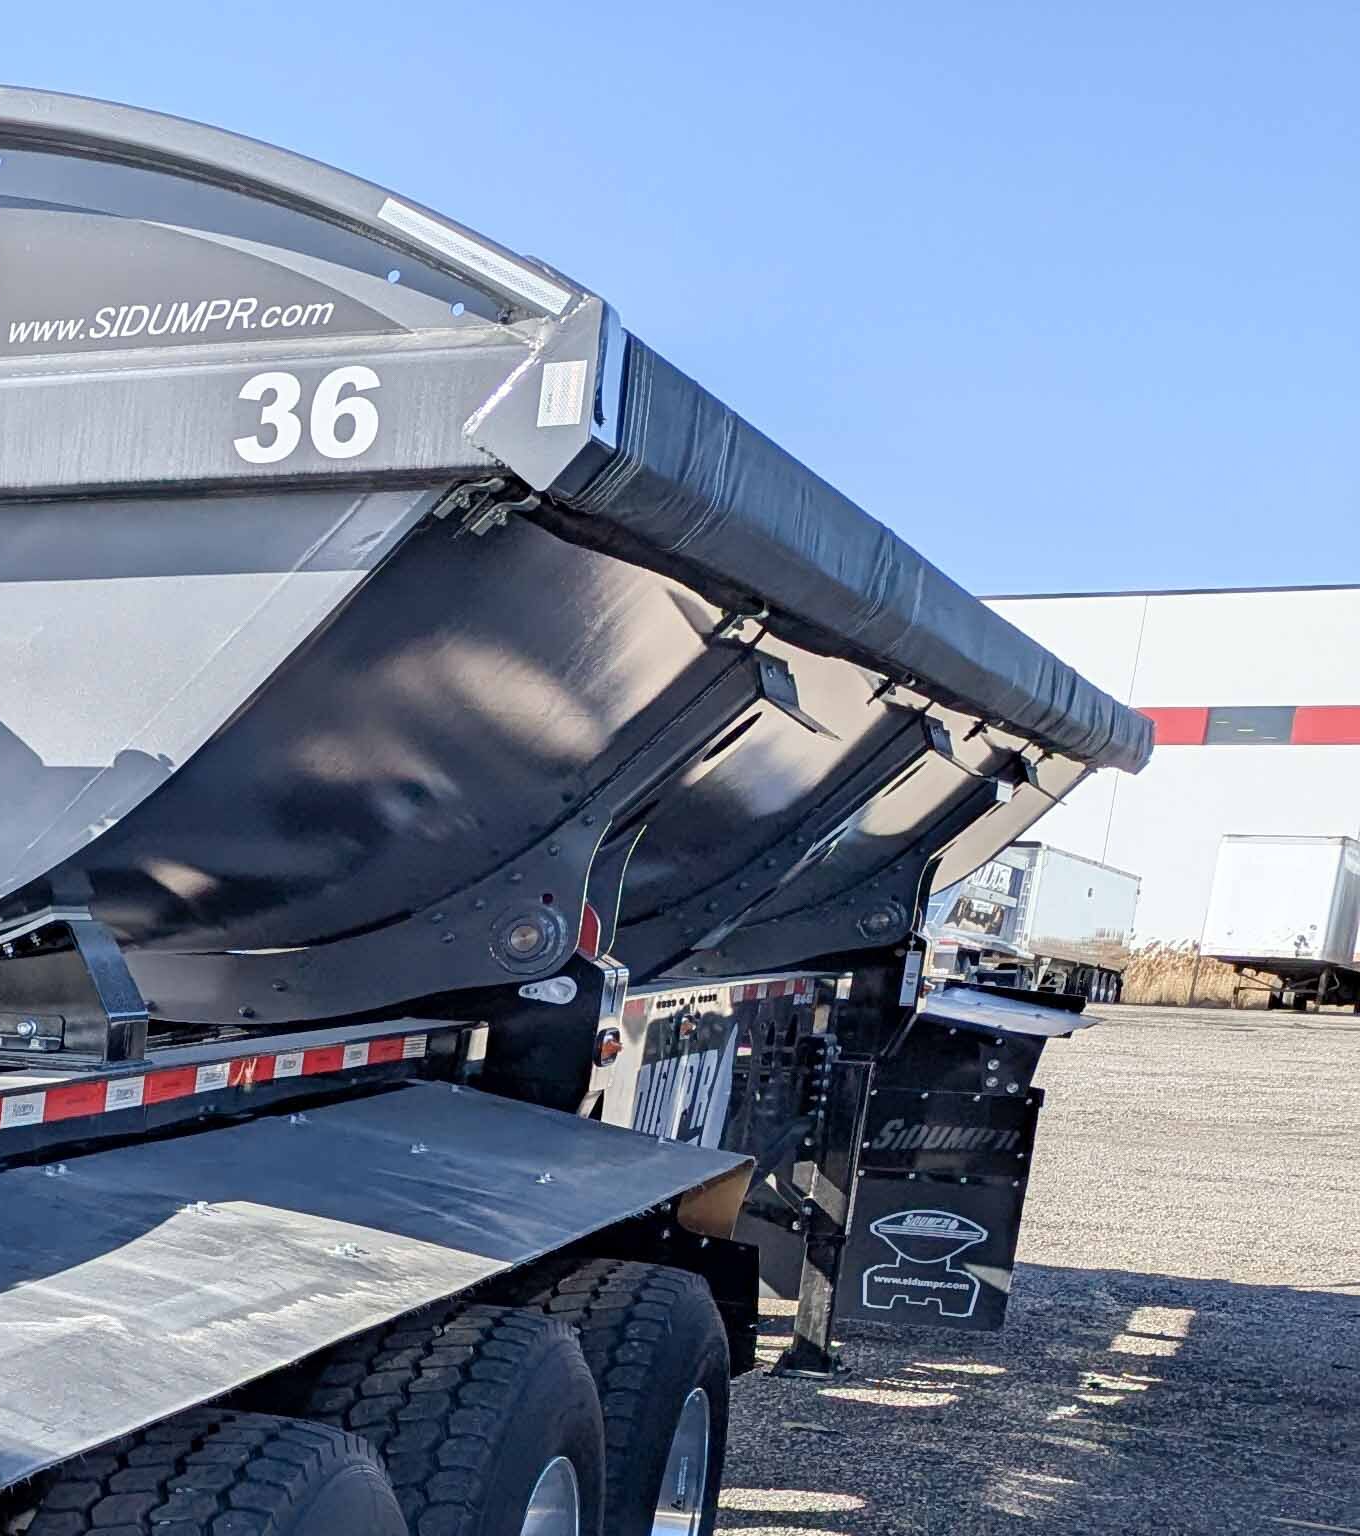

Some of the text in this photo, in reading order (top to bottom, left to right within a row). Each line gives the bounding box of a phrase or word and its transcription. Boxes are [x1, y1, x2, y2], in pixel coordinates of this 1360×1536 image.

[8, 296, 335, 345] www.SIDUMPR.com
[233, 365, 380, 464] 36
[873, 1274, 970, 1292] www.sidumpr.com
